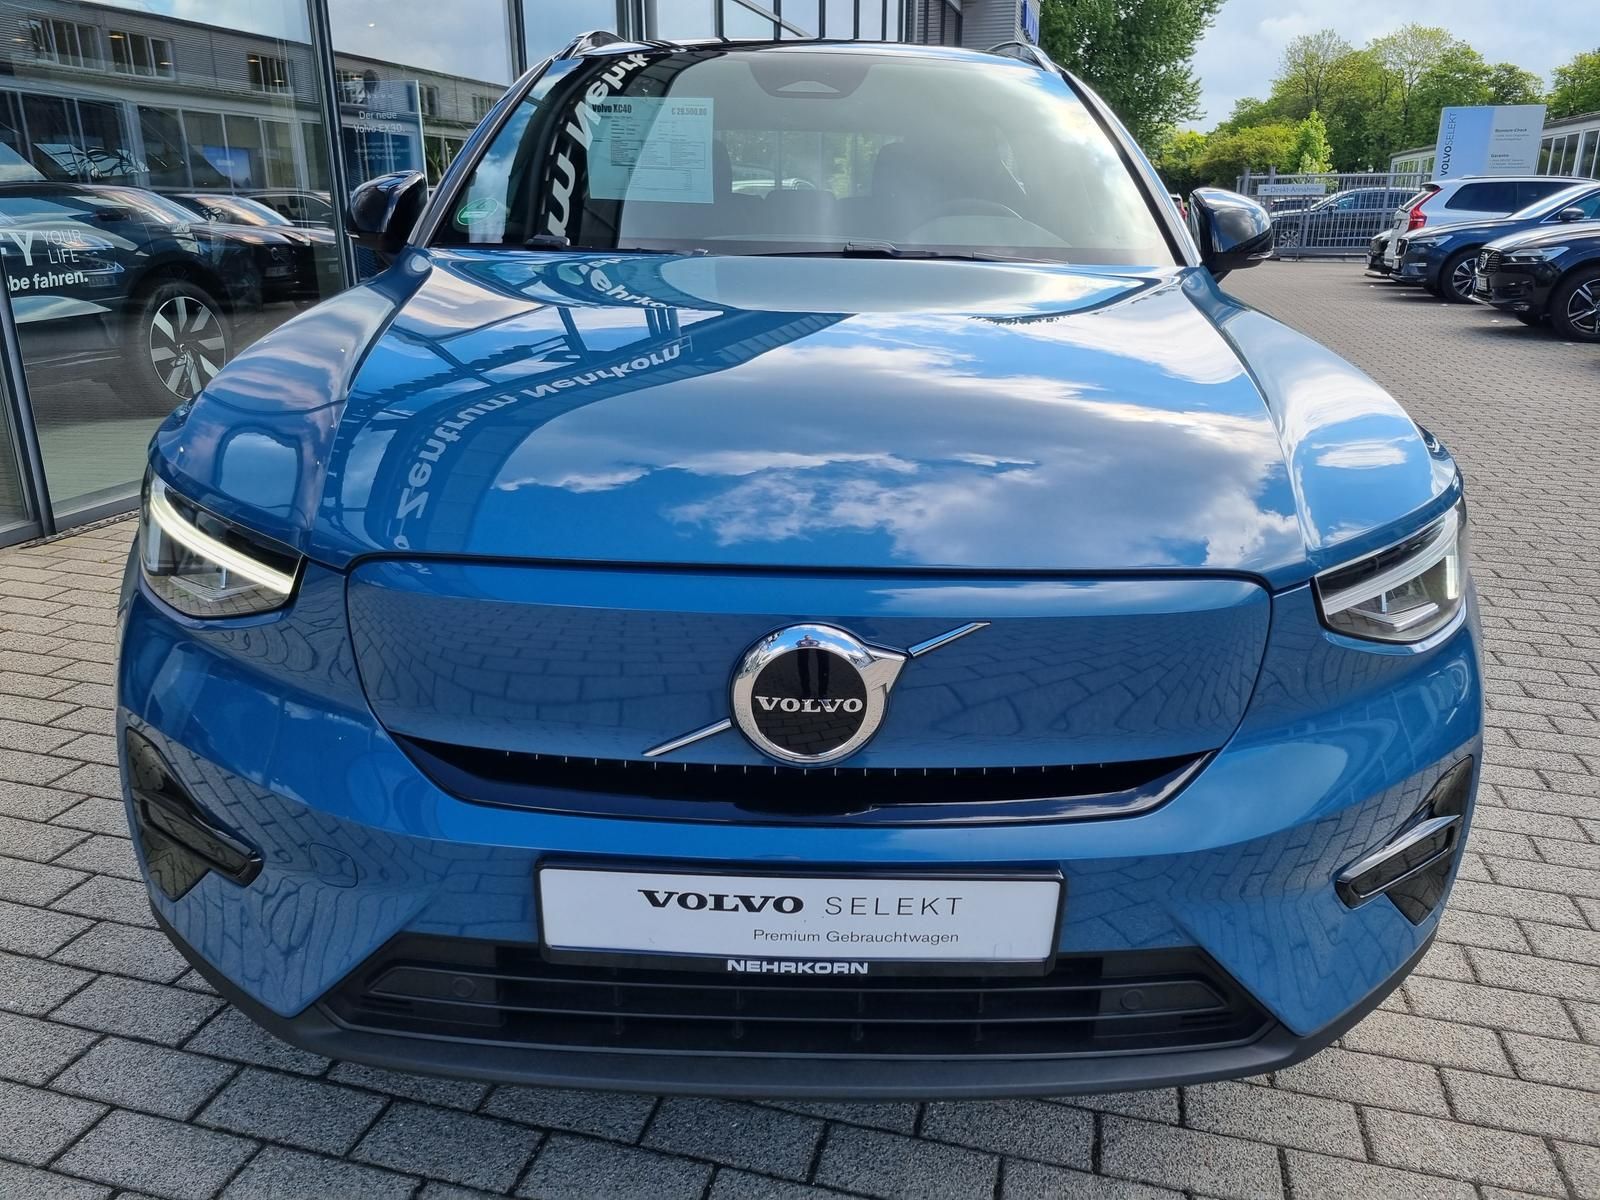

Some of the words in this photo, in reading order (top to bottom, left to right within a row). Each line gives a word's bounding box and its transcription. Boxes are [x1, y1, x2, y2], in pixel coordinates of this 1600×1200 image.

[359, 110, 374, 120] Der
[376, 111, 398, 120] neue
[592, 104, 612, 113] Volvo
[613, 104, 632, 114] XC40
[353, 123, 377, 134] Volvo
[40, 229, 84, 246] YOUR
[47, 248, 80, 265] LIFE
[8, 275, 30, 292] be
[32, 270, 89, 290] fahren.
[755, 695, 864, 713] VOLVO
[637, 889, 804, 914] VOLVO
[825, 896, 963, 916] SELEKT
[753, 929, 820, 943] Premium
[826, 930, 960, 946] Gebrauchtwagen
[727, 959, 869, 975] NEHRKORN
